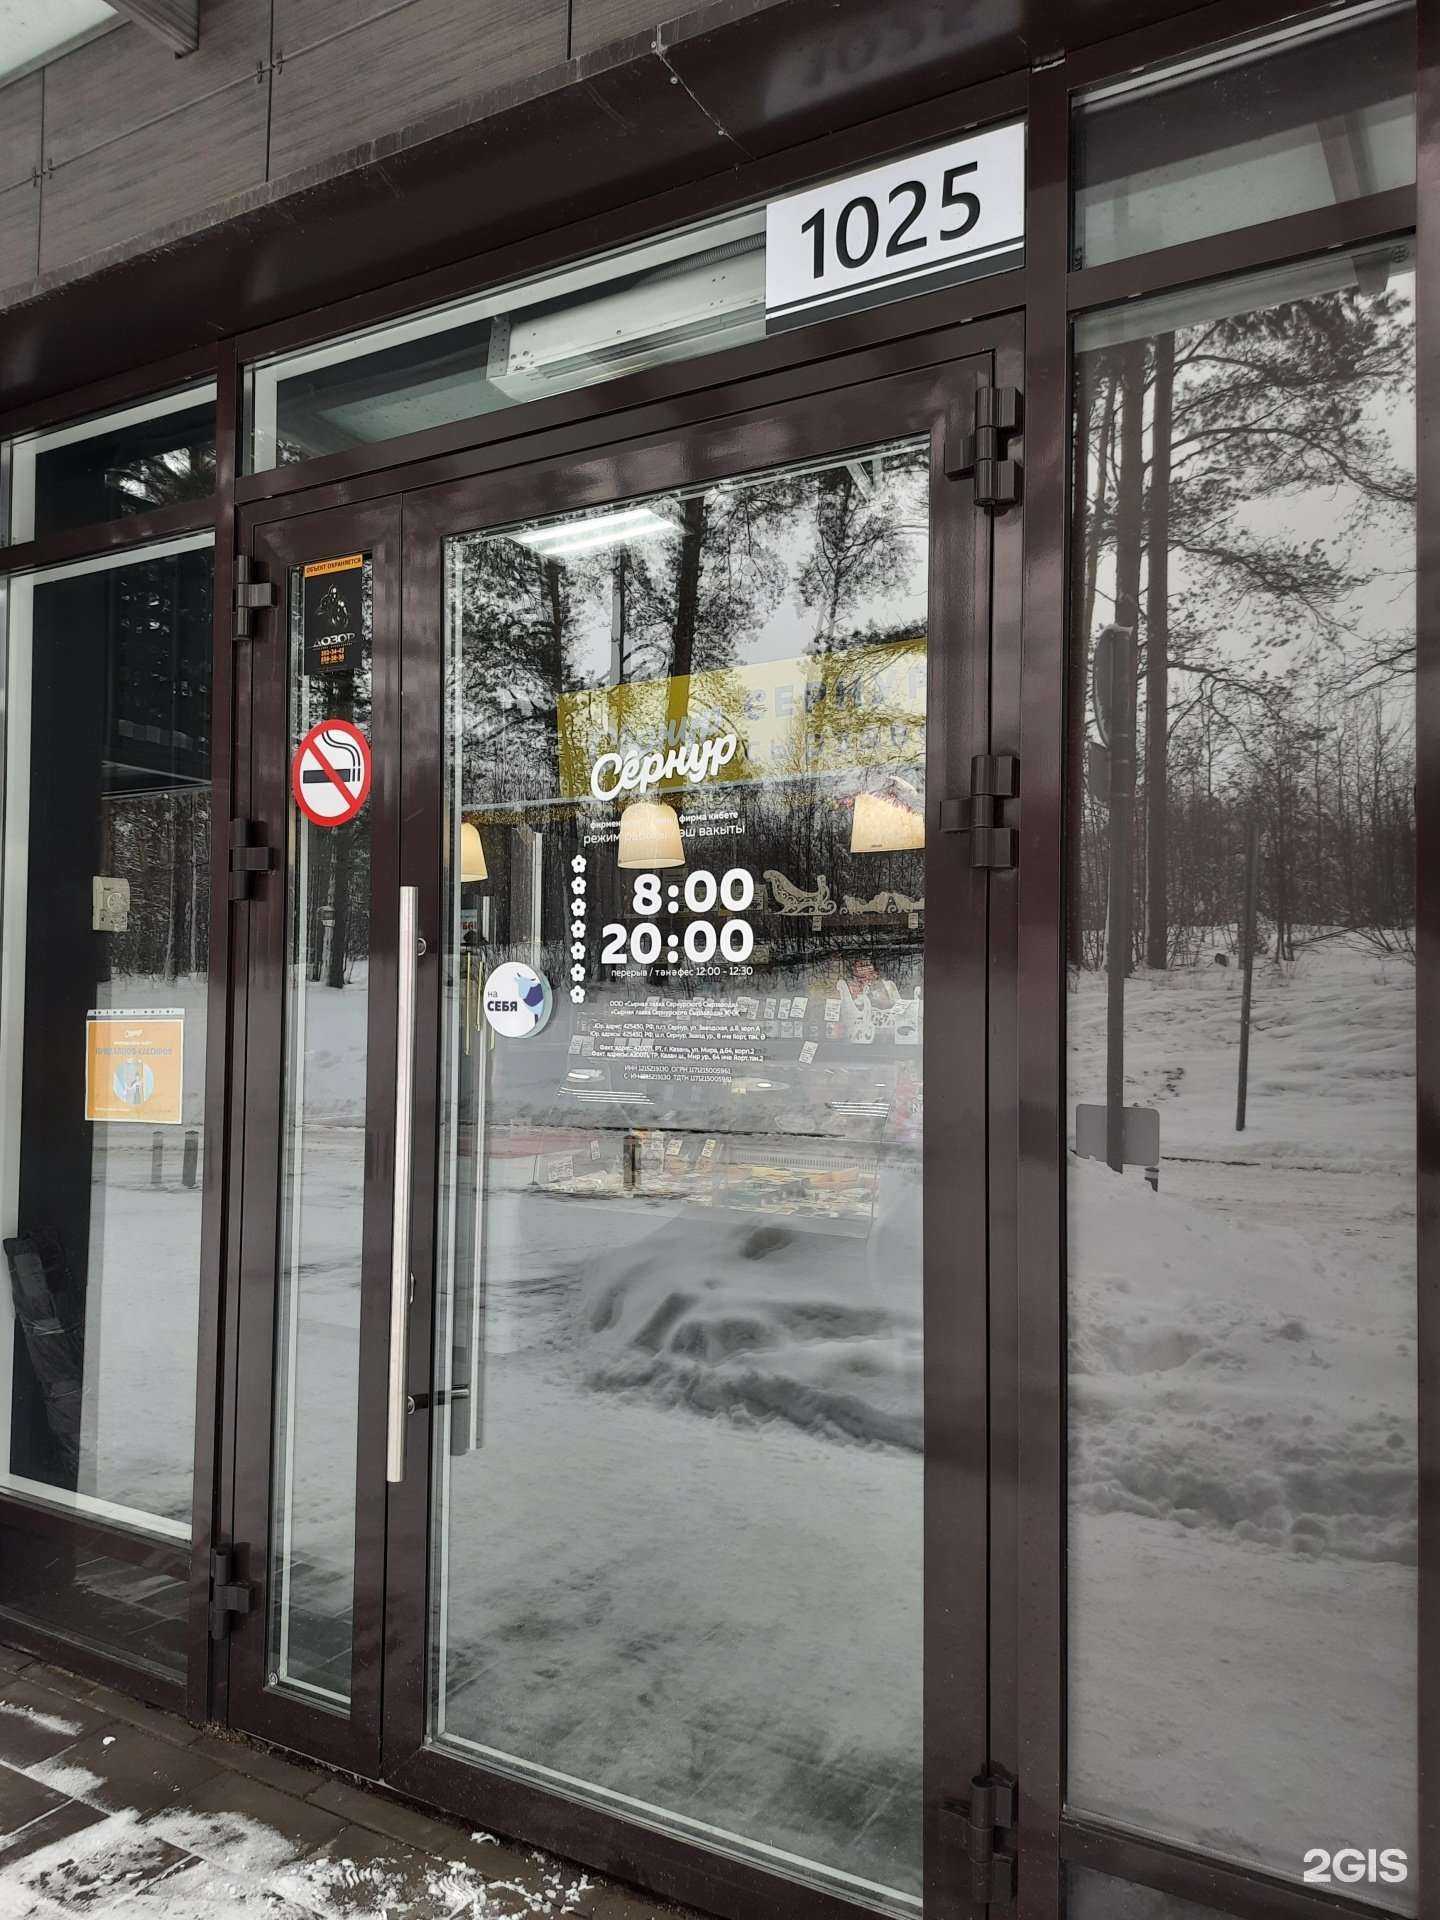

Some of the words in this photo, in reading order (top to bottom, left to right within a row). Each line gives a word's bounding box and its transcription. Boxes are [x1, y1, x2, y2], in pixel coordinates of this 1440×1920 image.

[801, 160, 981, 280] 1025
[312, 633, 356, 648] ДОЗОР
[679, 812, 707, 824] фирма
[700, 824, 745, 836] вакыты
[632, 867, 754, 916] 8:00
[601, 919, 754, 965] 20:00
[611, 968, 648, 978] перерыв
[696, 966, 721, 976] 12:00
[729, 966, 754, 976] 12:30
[487, 1000, 518, 1012] СЕБЯ
